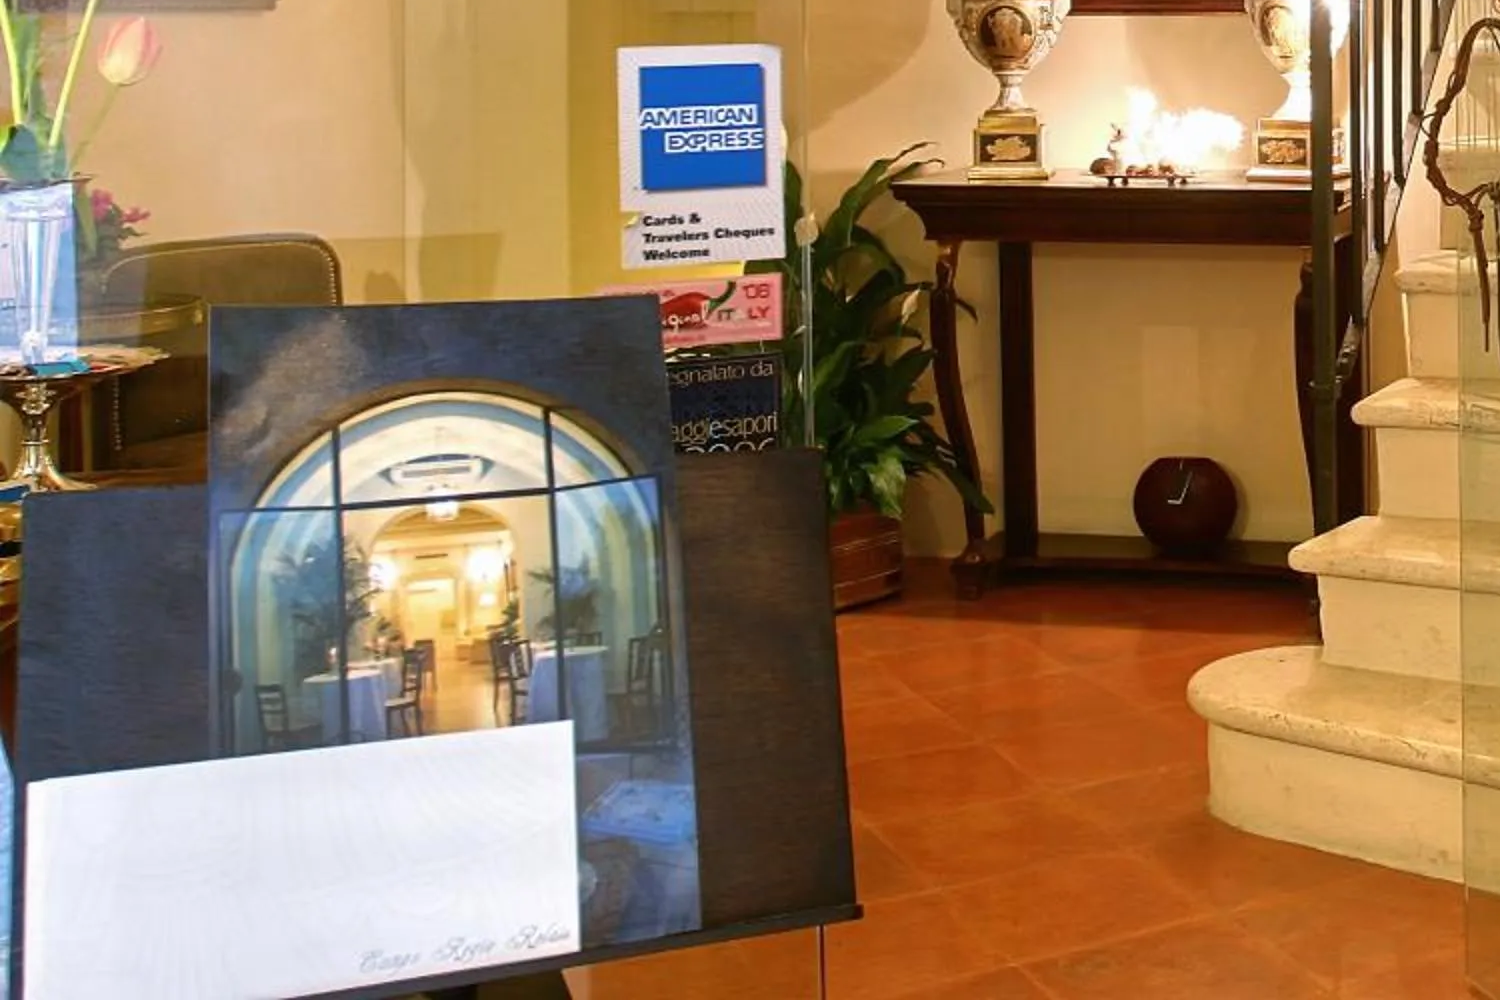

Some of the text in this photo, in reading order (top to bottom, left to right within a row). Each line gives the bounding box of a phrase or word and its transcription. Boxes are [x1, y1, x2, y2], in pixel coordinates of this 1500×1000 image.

[640, 107, 754, 127] AMERICAN
[667, 132, 764, 150] EXPRESS
[643, 213, 702, 226] Cards &
[643, 227, 775, 243] Travelers Cheques
[643, 248, 710, 260] Welcome
[750, 361, 773, 376] da
[671, 412, 777, 445] aggiesapori
